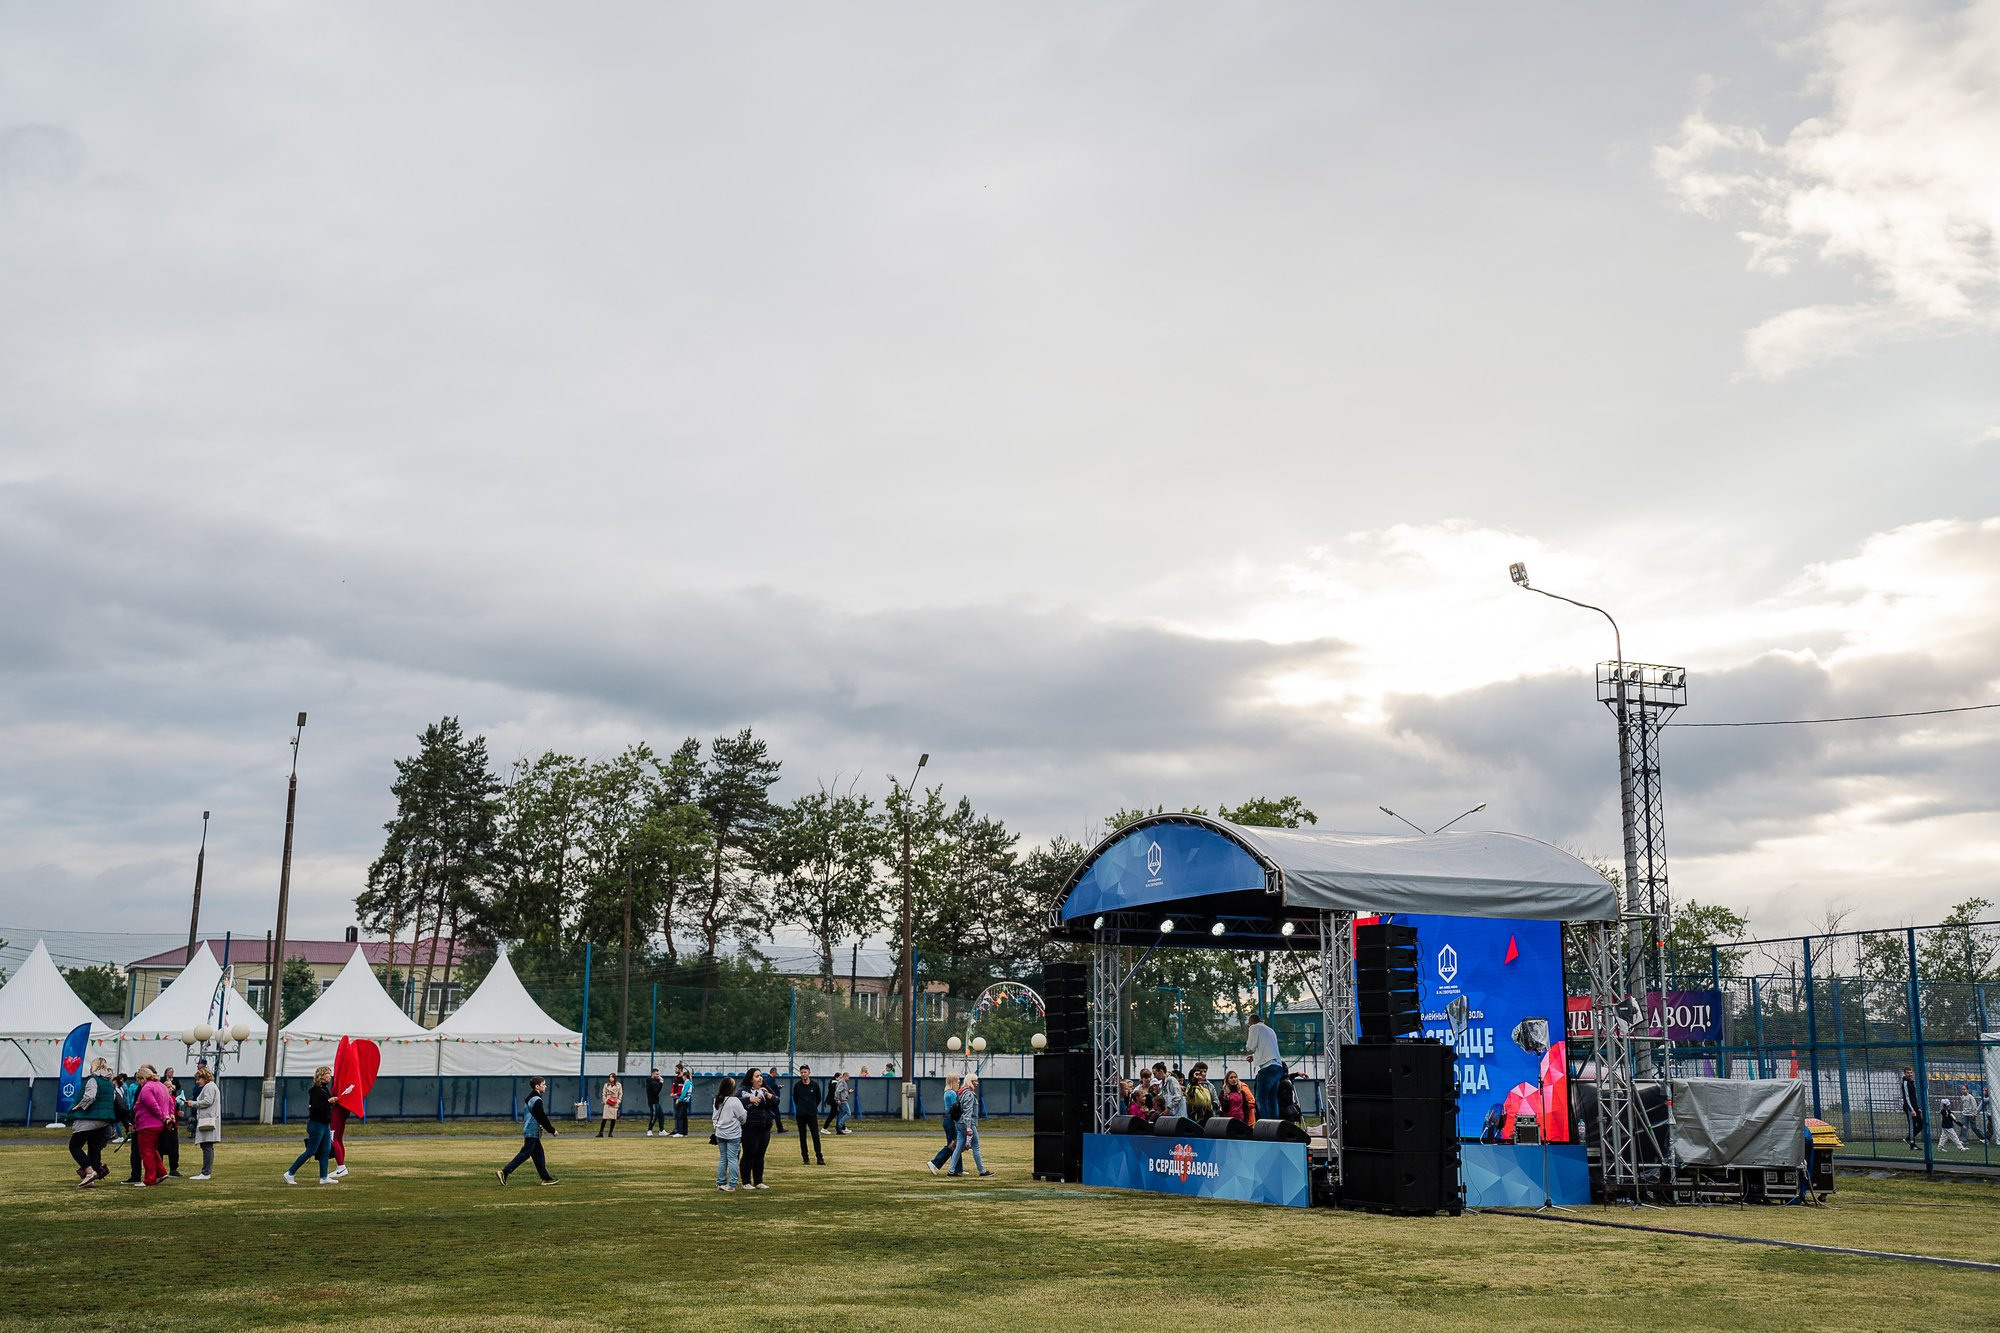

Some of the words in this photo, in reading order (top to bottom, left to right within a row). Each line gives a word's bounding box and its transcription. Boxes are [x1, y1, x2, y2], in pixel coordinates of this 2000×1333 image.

[1421, 1010, 1448, 1021] емейный
[1650, 1005, 1712, 1032] АВОД!
[1149, 1158, 1154, 1171] В
[1156, 1159, 1185, 1175] СЕРДЦЕ
[1186, 1161, 1219, 1178] ЗАВОДА
